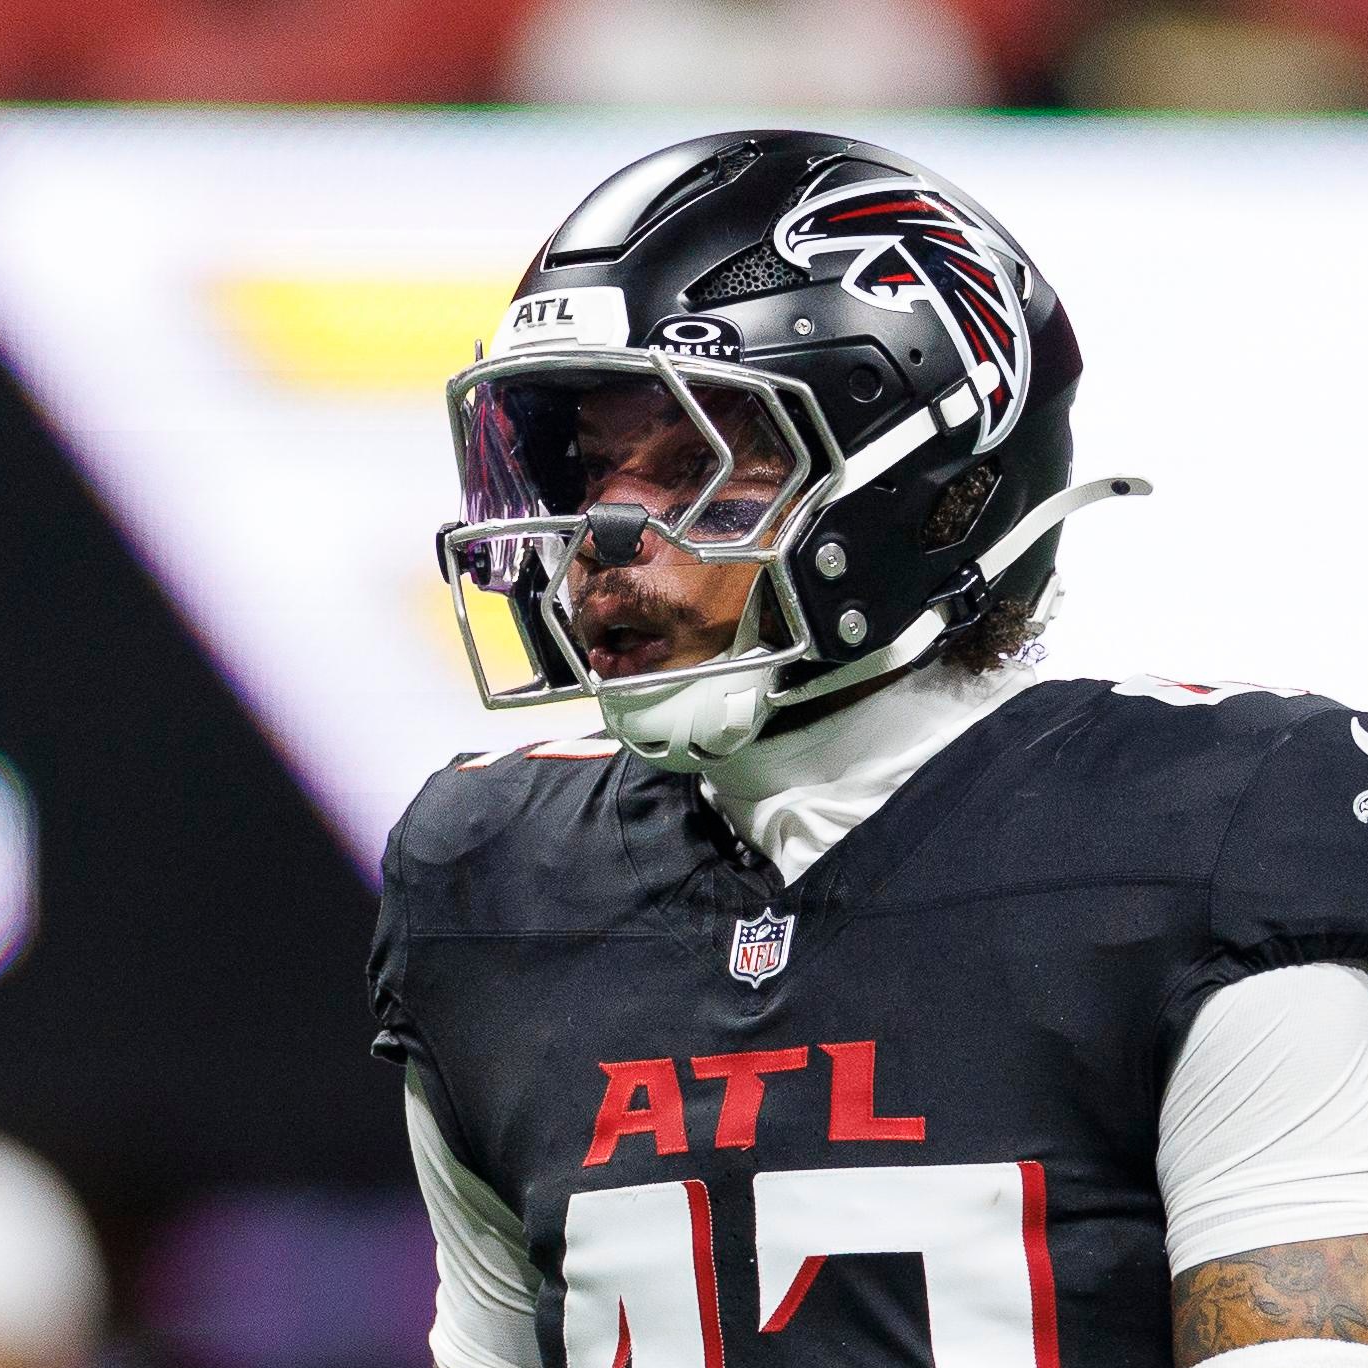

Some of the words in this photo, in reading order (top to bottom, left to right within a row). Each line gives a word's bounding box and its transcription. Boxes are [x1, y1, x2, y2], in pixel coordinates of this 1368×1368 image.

[513, 298, 574, 328] ATL
[739, 942, 776, 973] NFL
[582, 1040, 927, 1168] ATL
